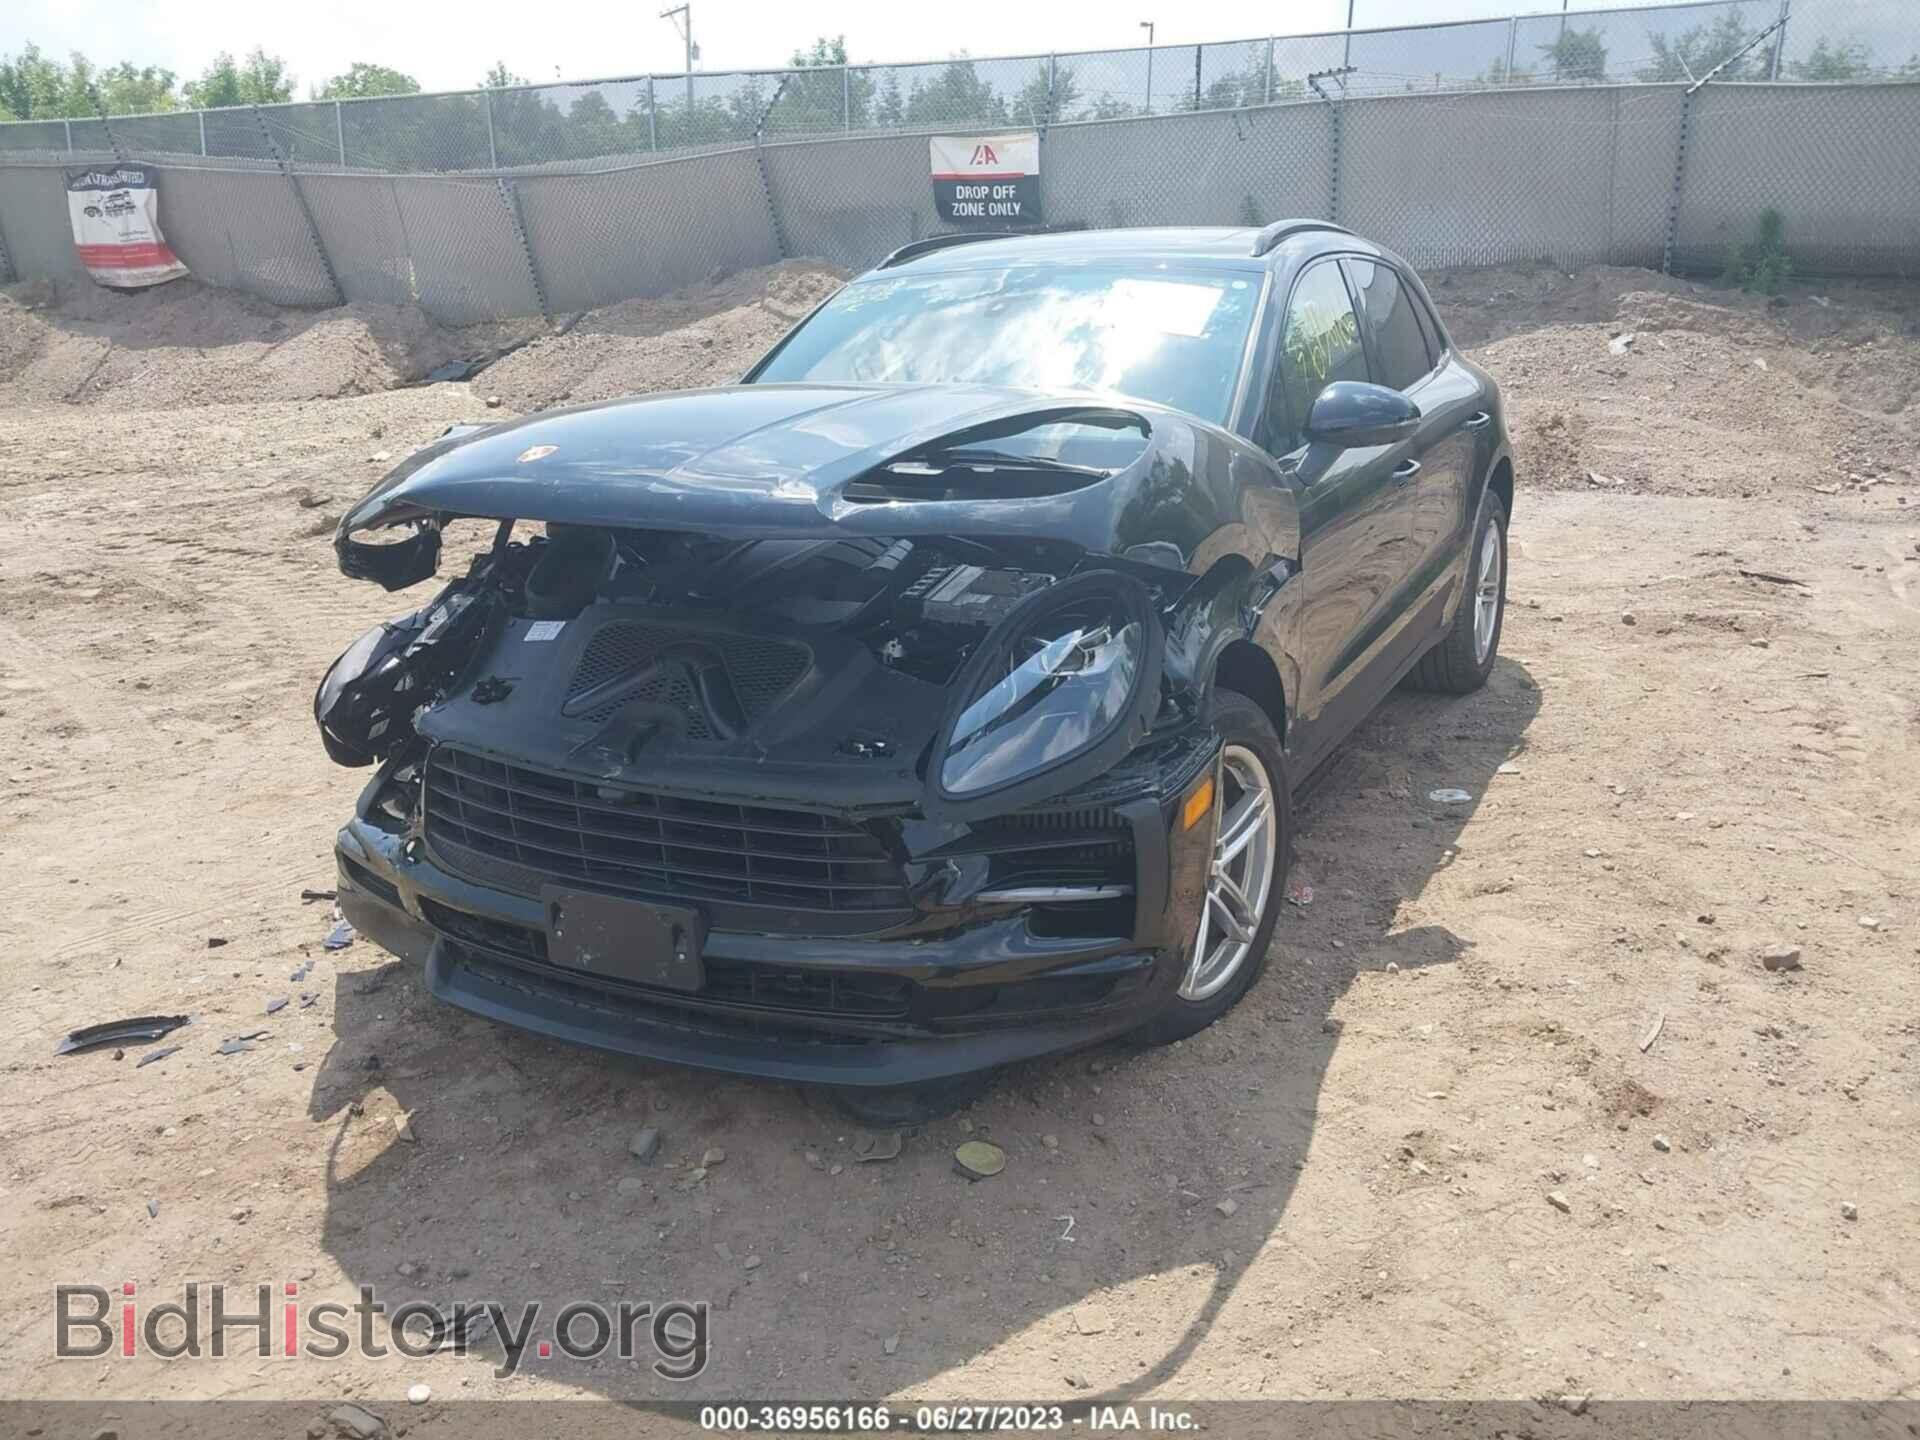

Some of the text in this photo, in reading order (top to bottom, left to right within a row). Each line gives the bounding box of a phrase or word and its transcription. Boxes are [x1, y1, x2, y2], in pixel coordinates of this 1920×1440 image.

[955, 185, 1017, 200] DROP OFF
[952, 203, 1022, 216] ZONE ONLY
